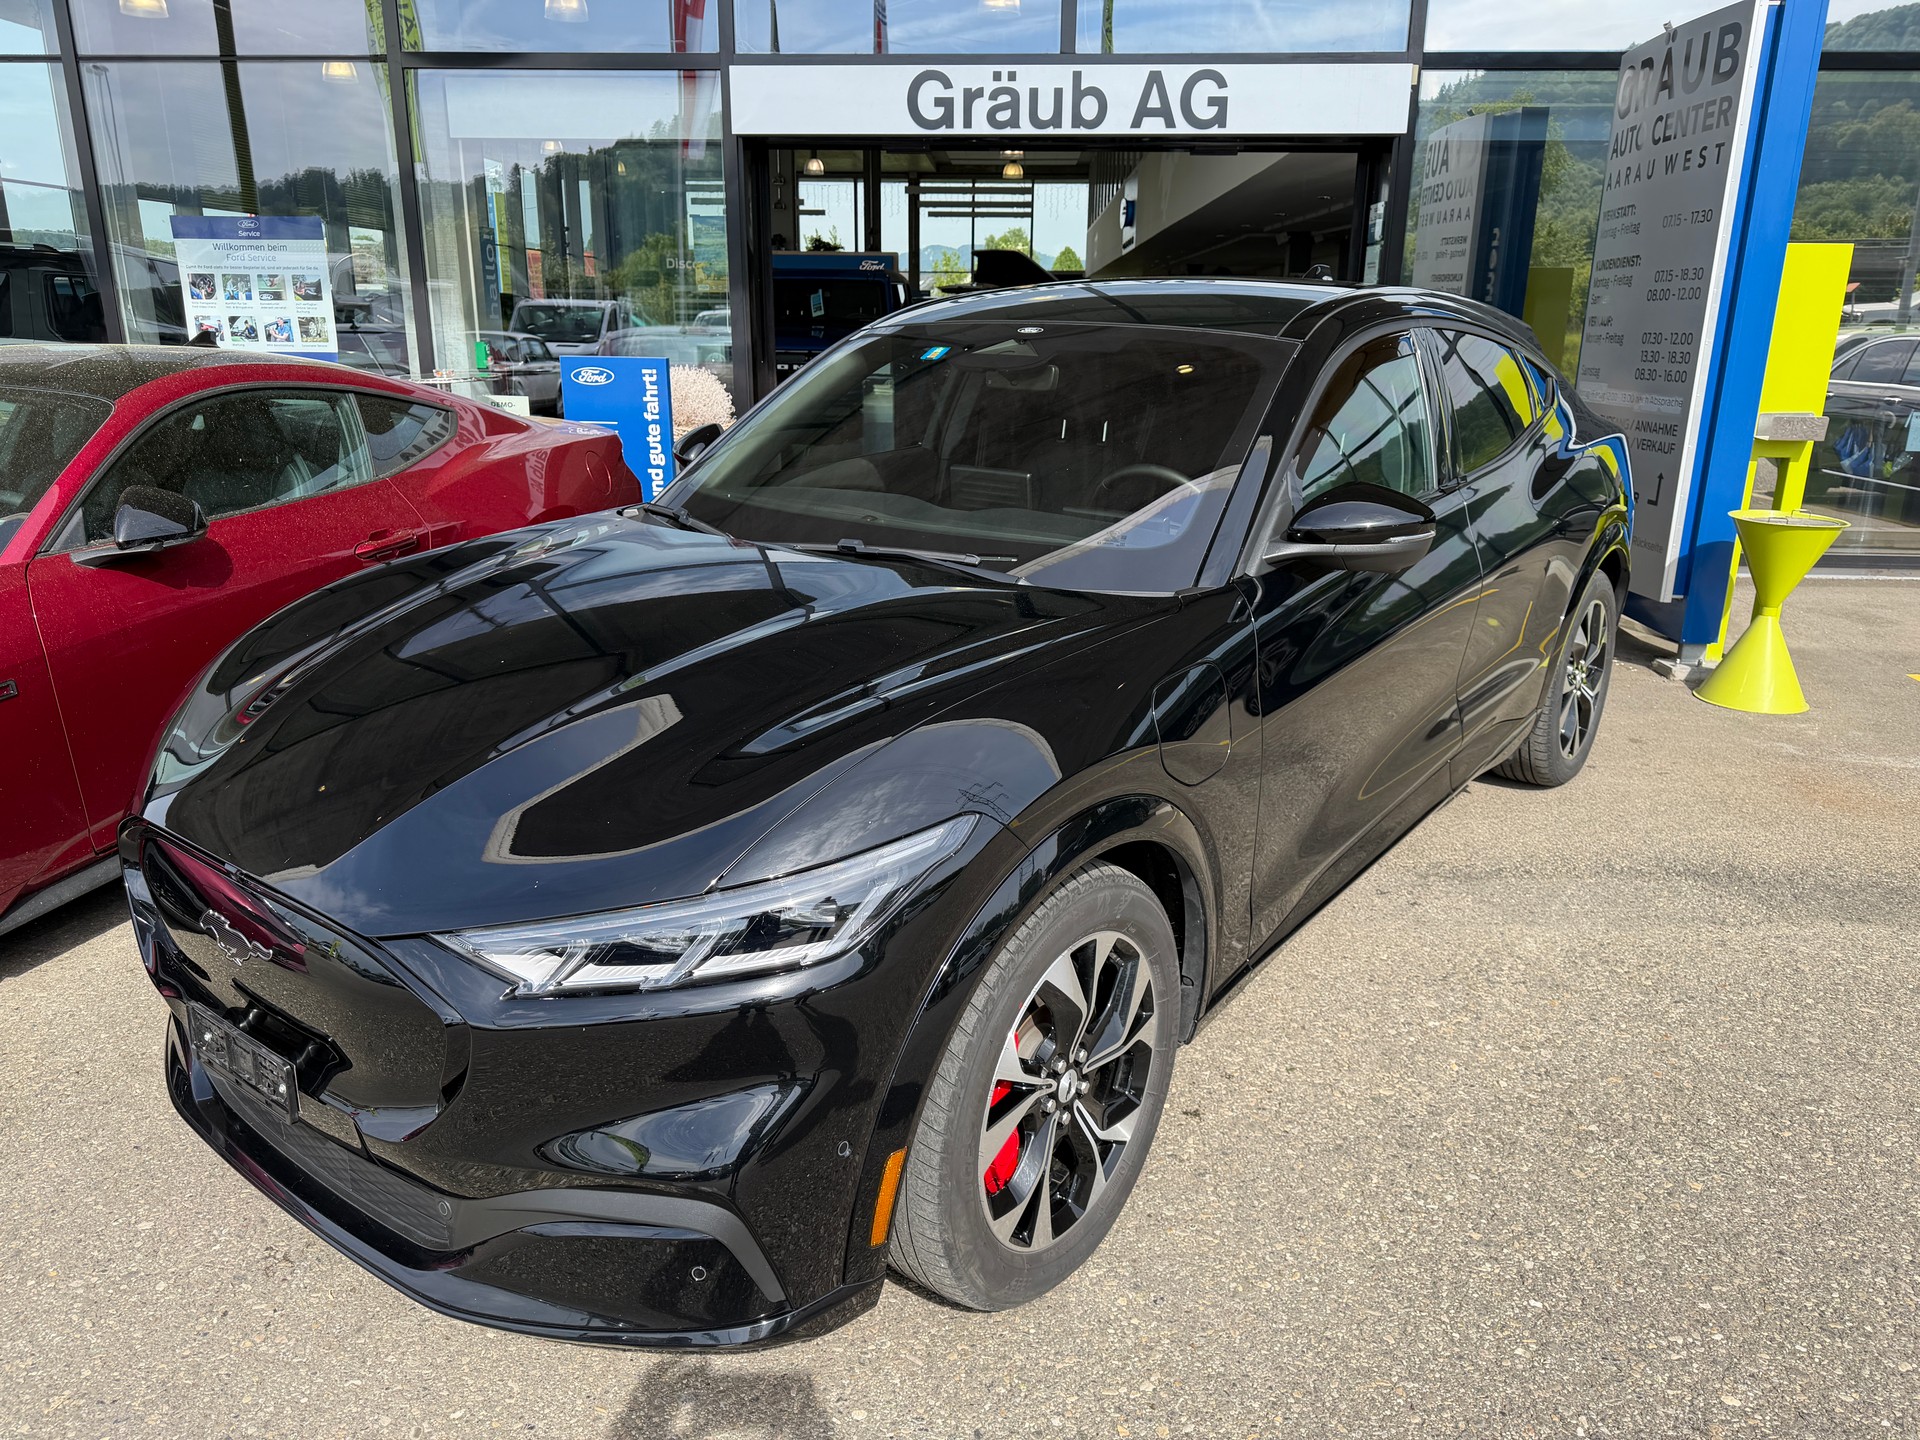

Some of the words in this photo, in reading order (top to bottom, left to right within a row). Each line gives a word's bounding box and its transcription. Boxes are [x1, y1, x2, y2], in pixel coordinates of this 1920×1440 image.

[1617, 21, 1743, 120] GRÄUB
[907, 69, 1108, 130] Gräub
[1130, 69, 1229, 130] AG
[1610, 120, 1648, 160] AUTO
[1652, 95, 1733, 146] CENTER
[1606, 158, 1656, 192] AARAU
[1665, 142, 1726, 176] WEST
[1620, 222, 1641, 236] Freitag
[1690, 208, 1714, 225] 17.30
[212, 242, 265, 252] Willkommen
[267, 243, 288, 252] beim
[226, 254, 246, 262] Ford
[247, 254, 277, 262] Service
[1613, 274, 1633, 287] Freitag
[1680, 267, 1704, 281] 18.30
[1646, 288, 1671, 302] 08.00
[1678, 287, 1702, 300] 12.00
[1605, 331, 1625, 347] Freitag
[1641, 331, 1663, 345] 07.30
[1670, 332, 1694, 346] 12.00
[1640, 350, 1660, 363] 13.30
[1667, 351, 1691, 364] 18.30
[577, 369, 608, 383] Ford
[1634, 368, 1657, 381] 08.30
[1663, 369, 1688, 383] 16.00
[641, 368, 661, 420] fahrt!
[1634, 420, 1679, 437] ANNAHME
[646, 421, 666, 467] gute
[1636, 438, 1676, 455] VERKAUF
